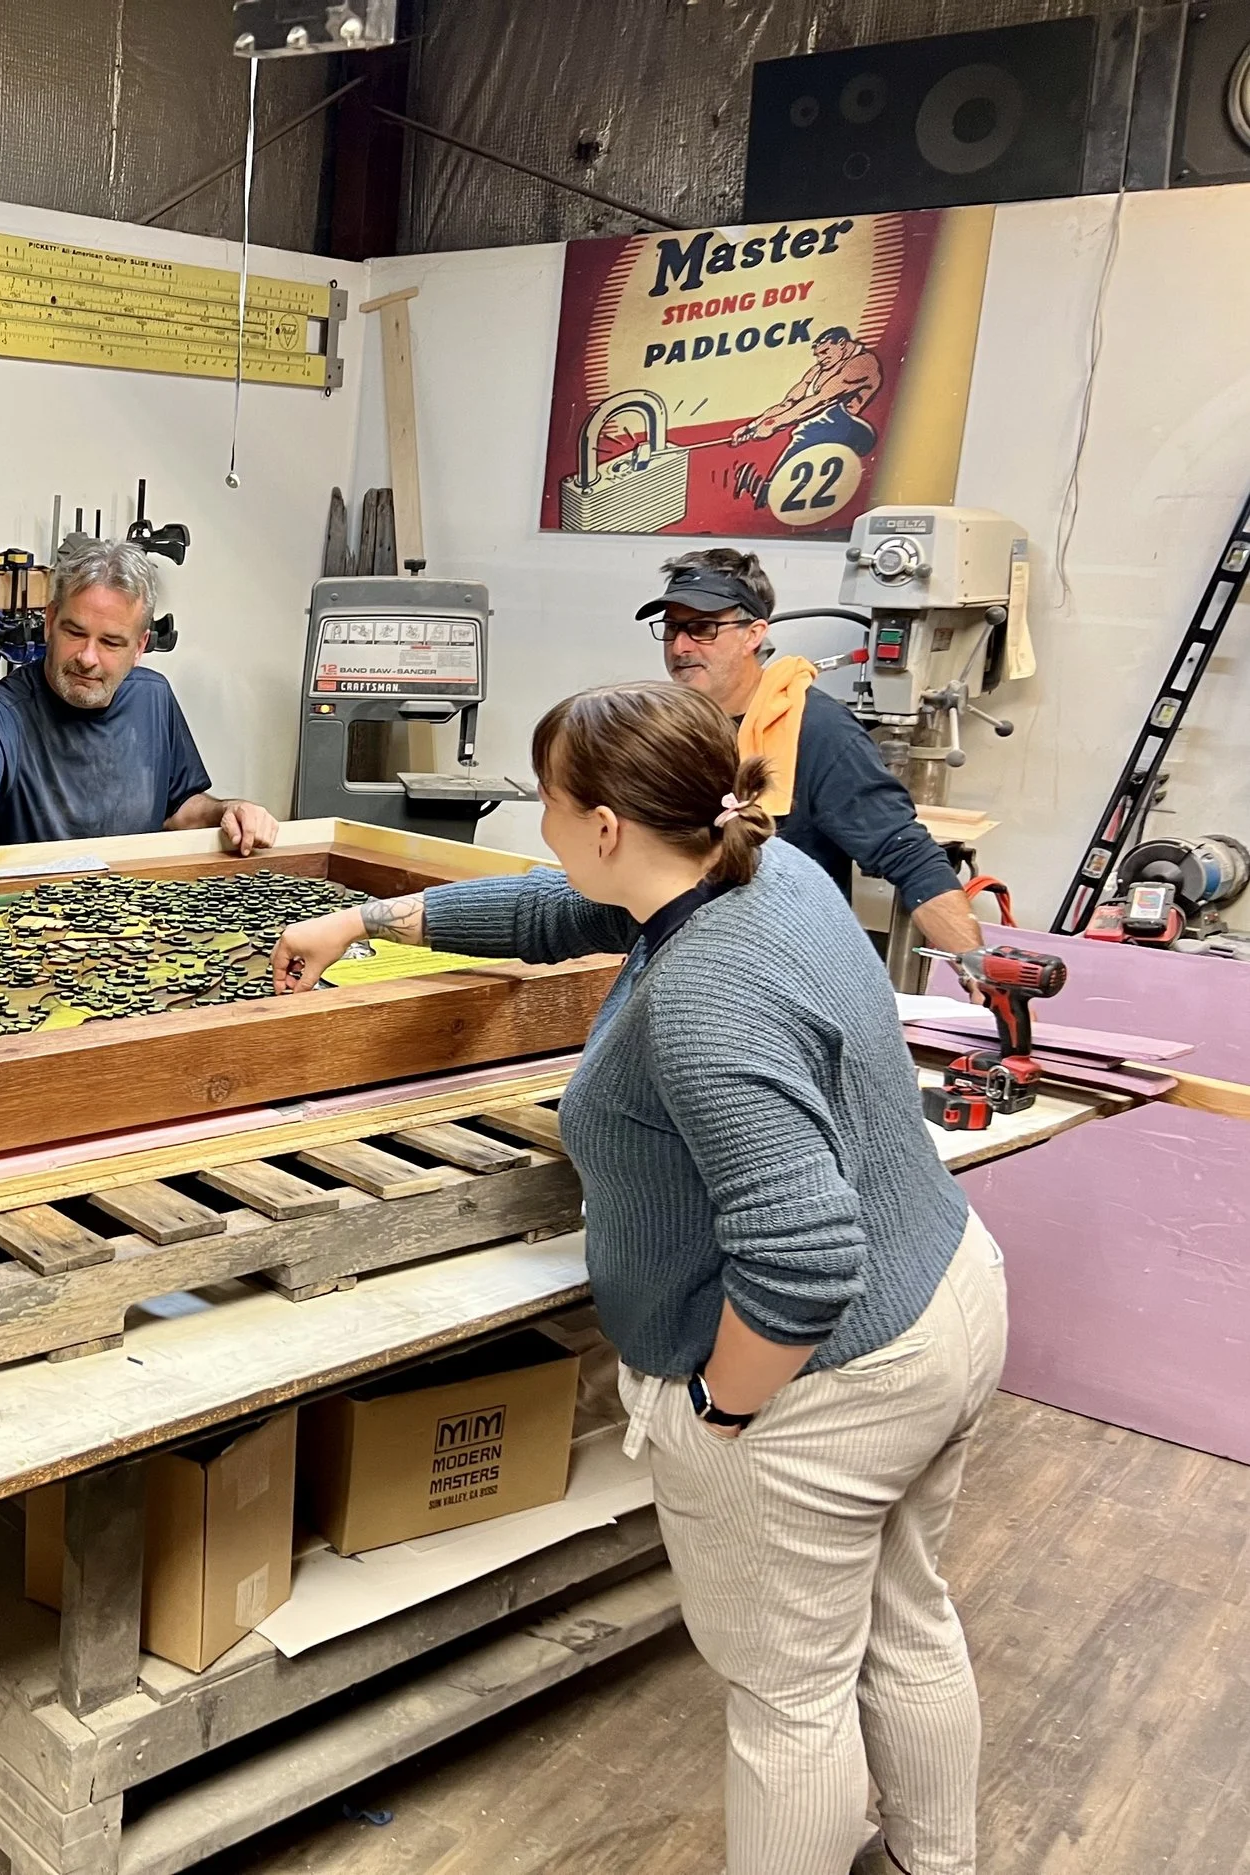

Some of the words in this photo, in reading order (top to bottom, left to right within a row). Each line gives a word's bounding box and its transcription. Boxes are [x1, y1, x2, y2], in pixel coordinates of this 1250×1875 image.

[28, 241, 57, 252] PICKETT
[105, 254, 127, 264] Quality
[130, 257, 149, 268] SLIDE
[151, 261, 173, 271] RULES
[648, 218, 854, 297] Master
[661, 291, 756, 326] STRONG
[762, 280, 815, 308] BOY
[643, 317, 815, 368] PADLOCK
[779, 456, 845, 513] 22
[886, 519, 927, 528] DELTA
[320, 664, 338, 673] 12
[340, 681, 400, 692] CRAFTSMAN
[432, 1444, 503, 1474] MODERN
[429, 1465, 500, 1495] MASTERS
